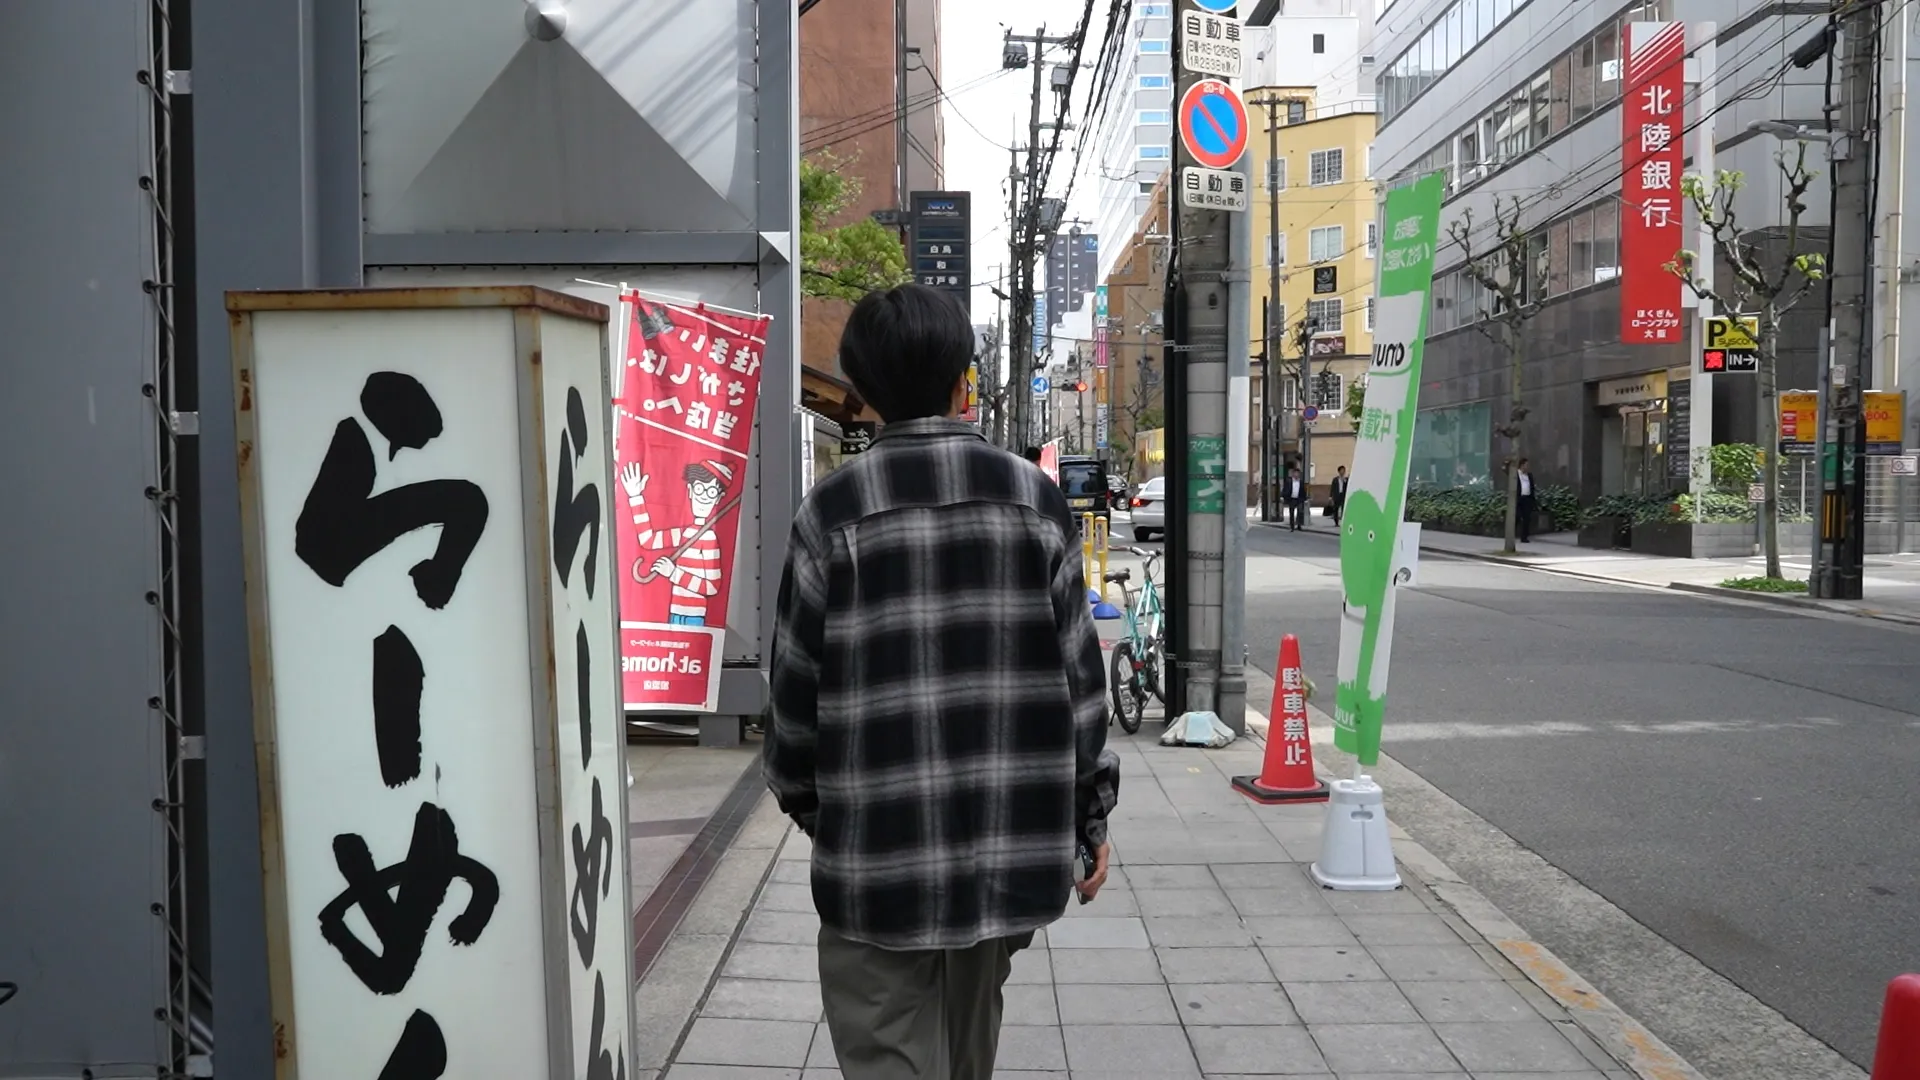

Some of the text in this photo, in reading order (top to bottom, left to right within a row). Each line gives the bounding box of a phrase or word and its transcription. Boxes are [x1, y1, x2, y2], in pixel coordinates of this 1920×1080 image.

[1187, 15, 1240, 42] 自動車
[1641, 85, 1672, 228] 北陸銀行
[1187, 172, 1244, 194] 自動車
[1631, 318, 1679, 328] ローンプラザ
[1637, 309, 1674, 318] ほくぎん
[1644, 329, 1666, 339] 大阪
[1708, 320, 1727, 347] P
[1729, 354, 1743, 365] IN
[1282, 666, 1307, 766] 駐車禁止
